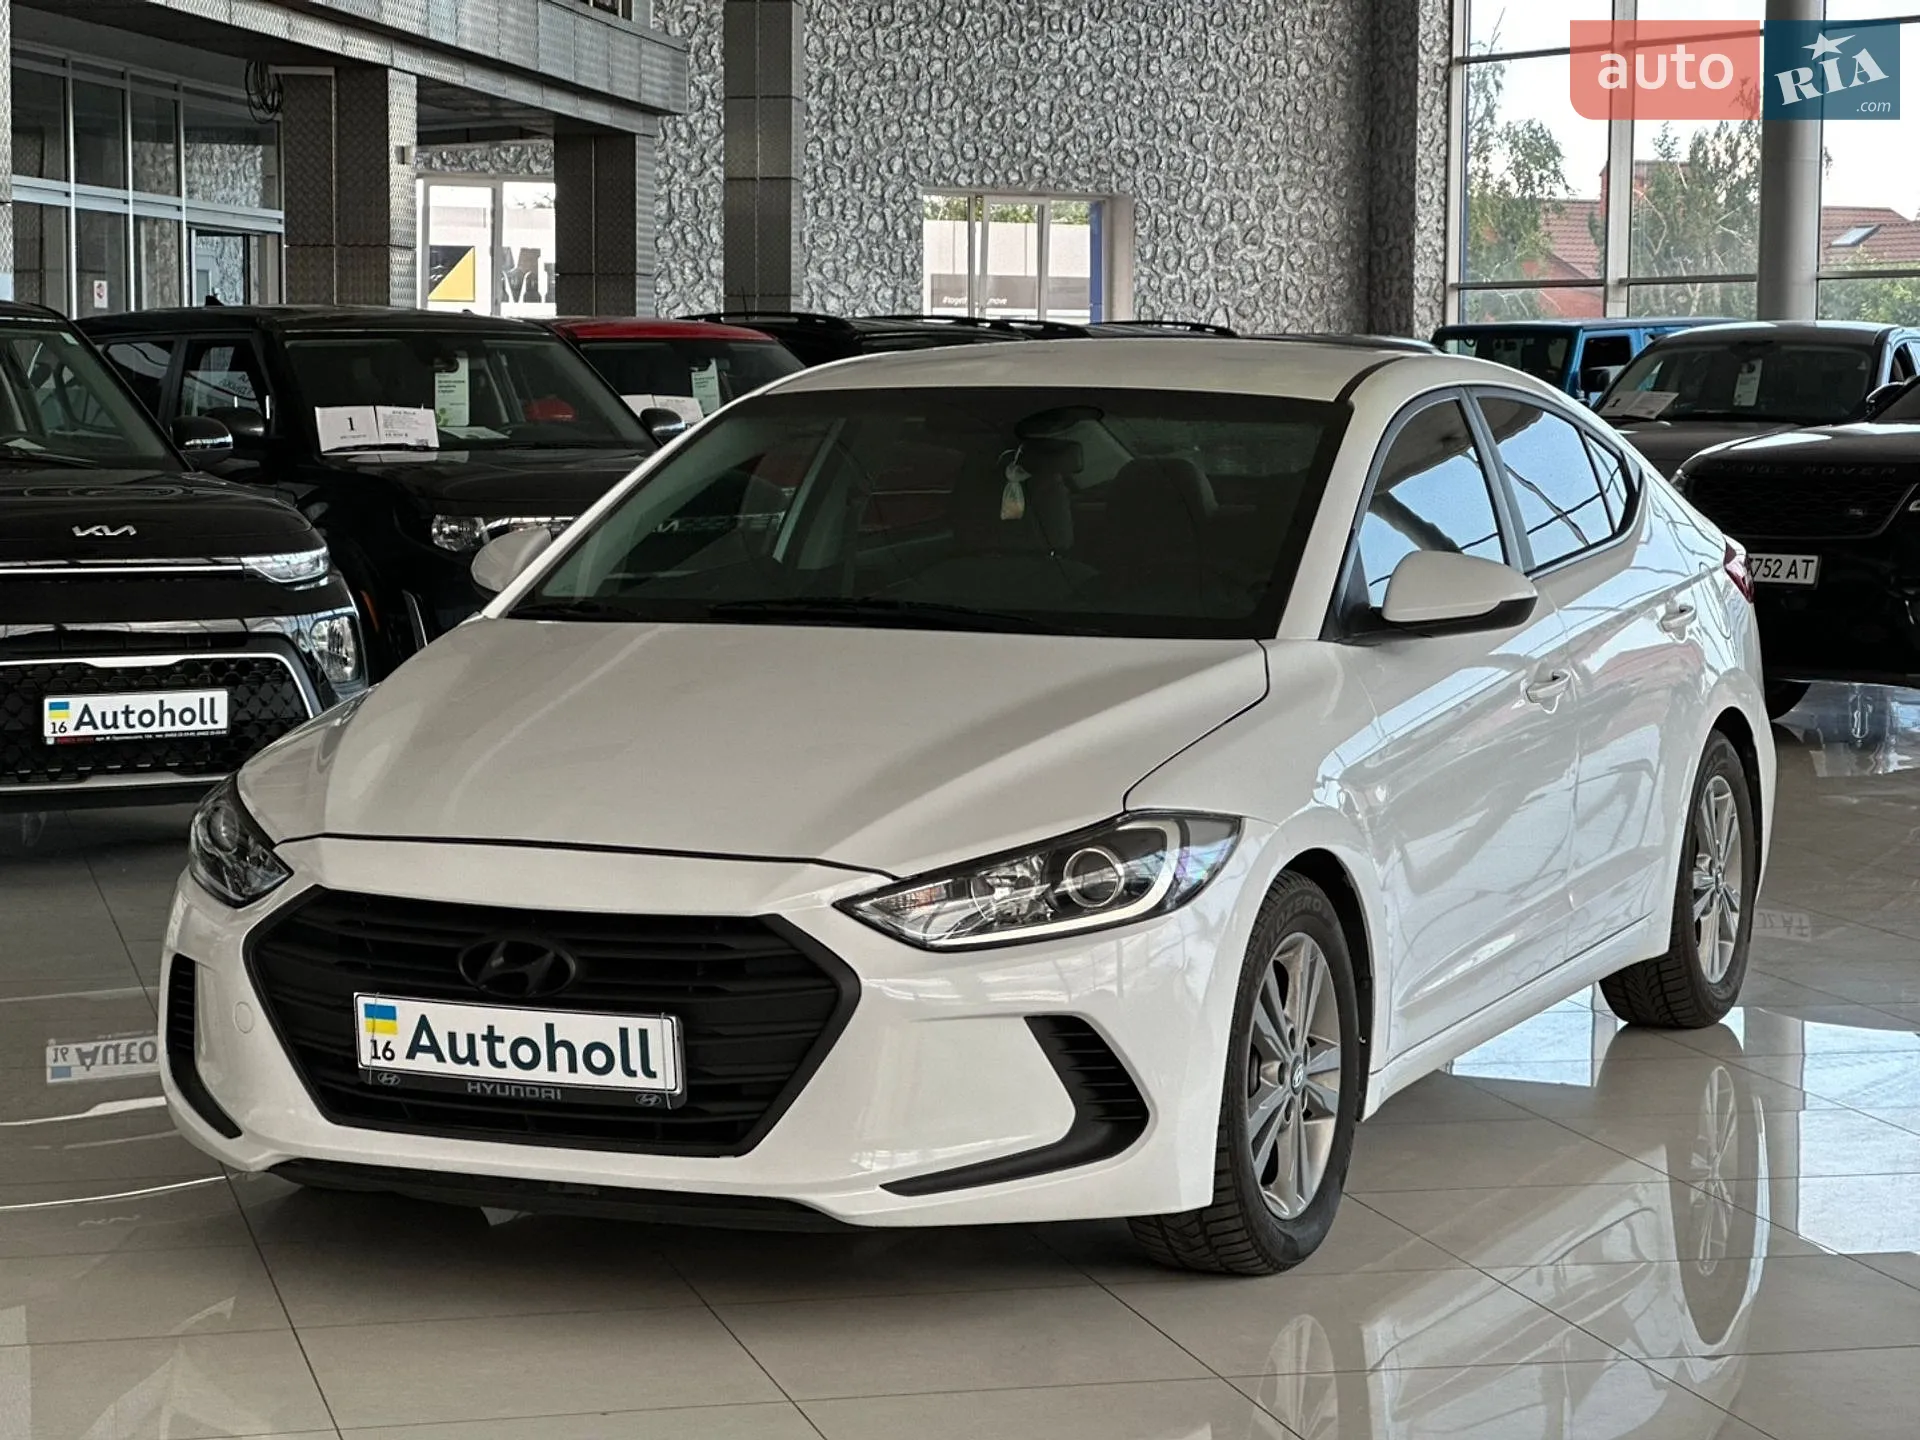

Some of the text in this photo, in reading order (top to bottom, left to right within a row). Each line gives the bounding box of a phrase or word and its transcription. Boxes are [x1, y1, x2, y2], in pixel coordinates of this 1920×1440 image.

[346, 416, 355, 431] 1
[1750, 558, 1815, 579] 752 AT
[51, 697, 218, 734] 16 Autoholl
[370, 1013, 657, 1079] 16 Autoholl
[467, 1081, 561, 1100] HYUNDAI
